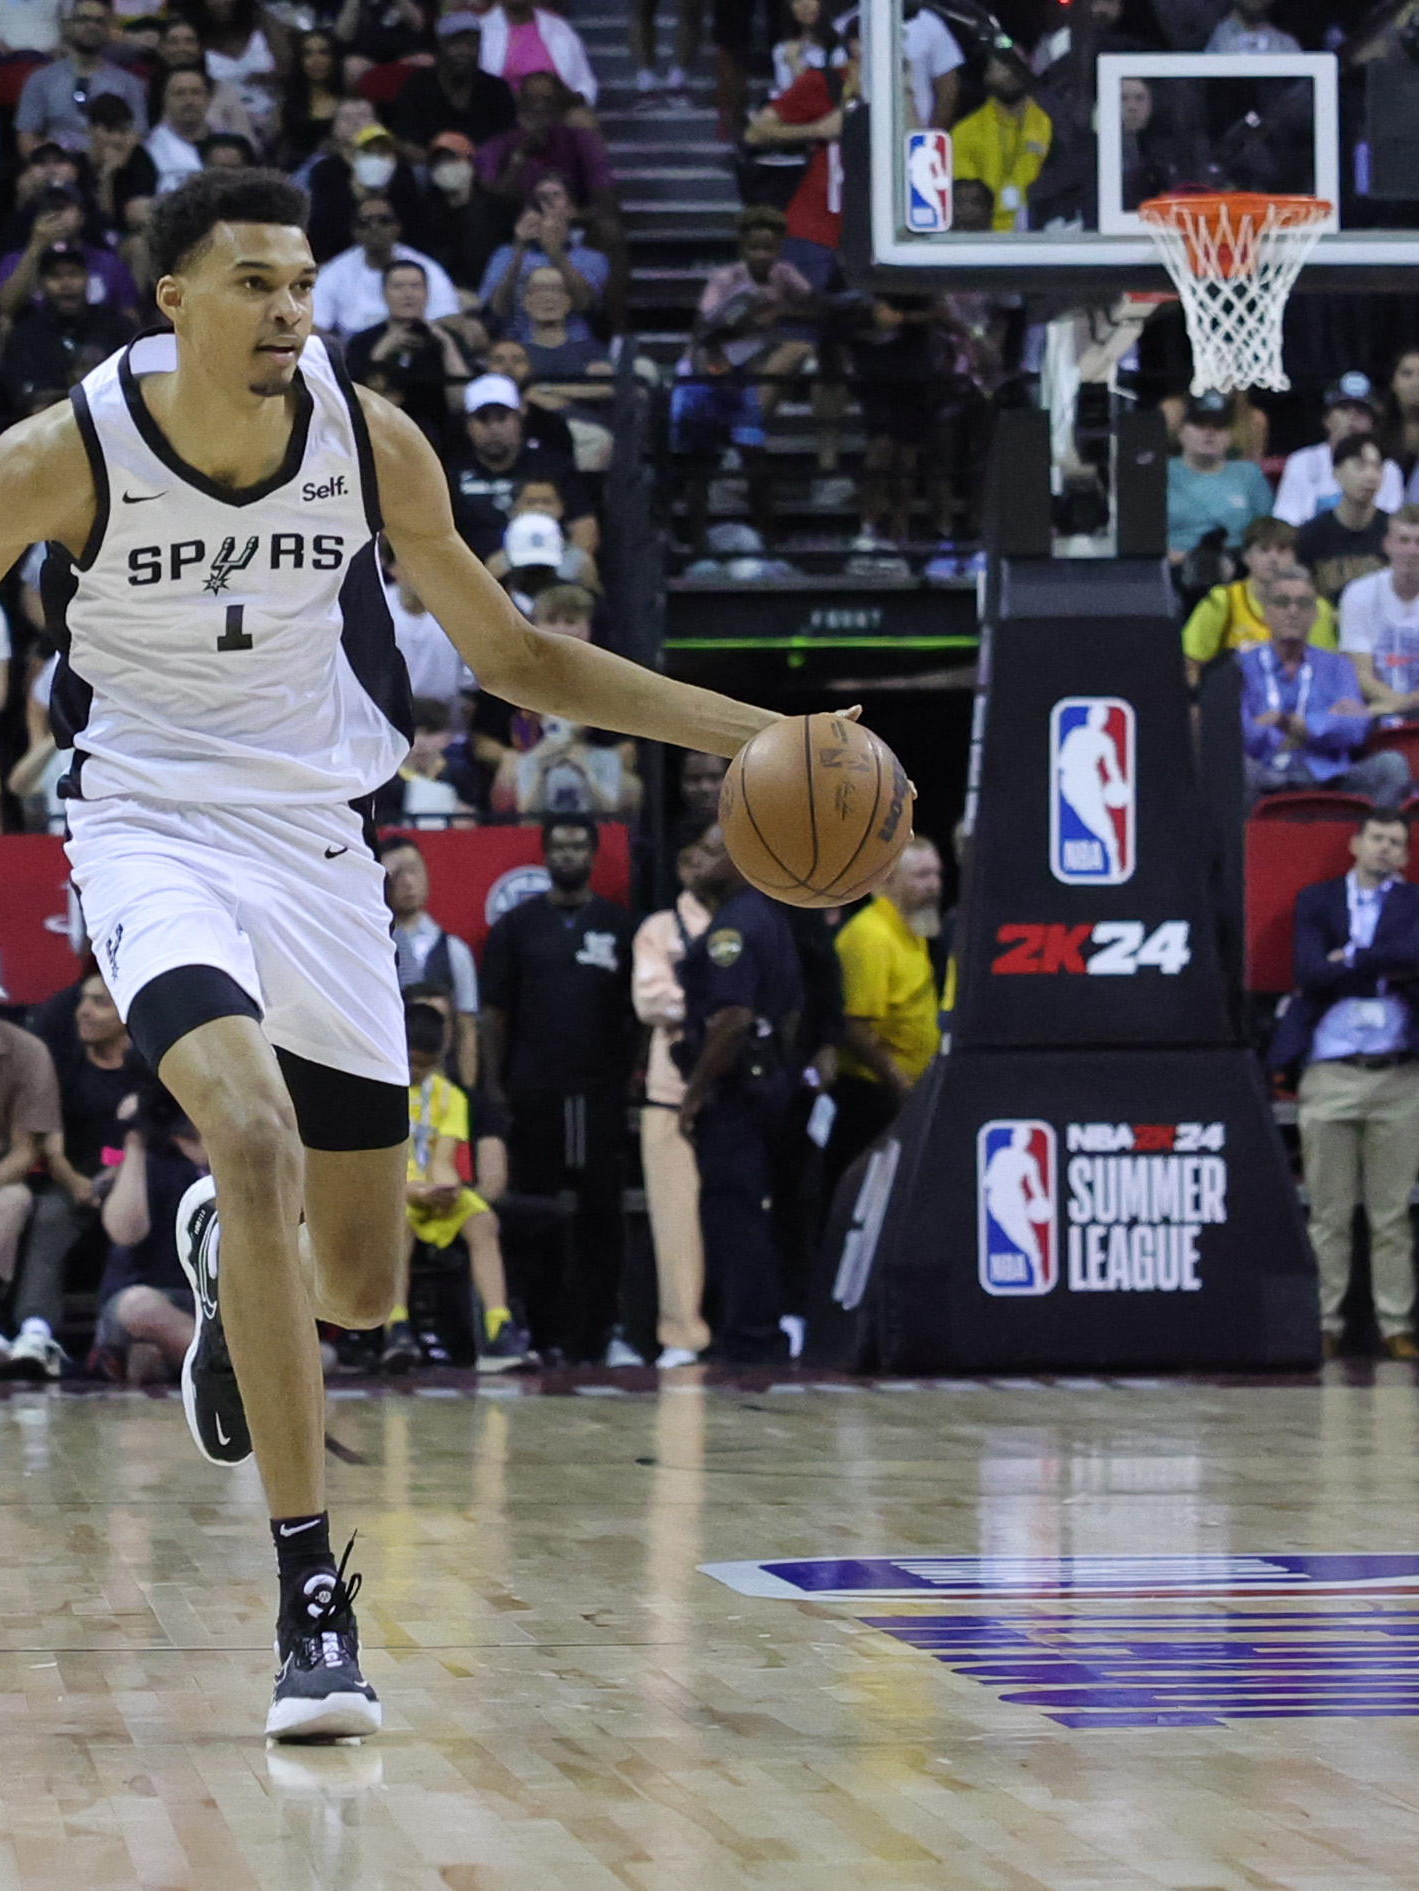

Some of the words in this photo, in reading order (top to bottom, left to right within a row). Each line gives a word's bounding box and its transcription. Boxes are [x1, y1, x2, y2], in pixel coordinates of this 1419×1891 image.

[302, 476, 349, 502] Self.
[128, 532, 345, 597] SPURS
[217, 604, 253, 652] 1
[991, 920, 1192, 975] 2K24
[1067, 1155, 1228, 1224] SUMMER
[1068, 1224, 1203, 1292] LEAGUE
